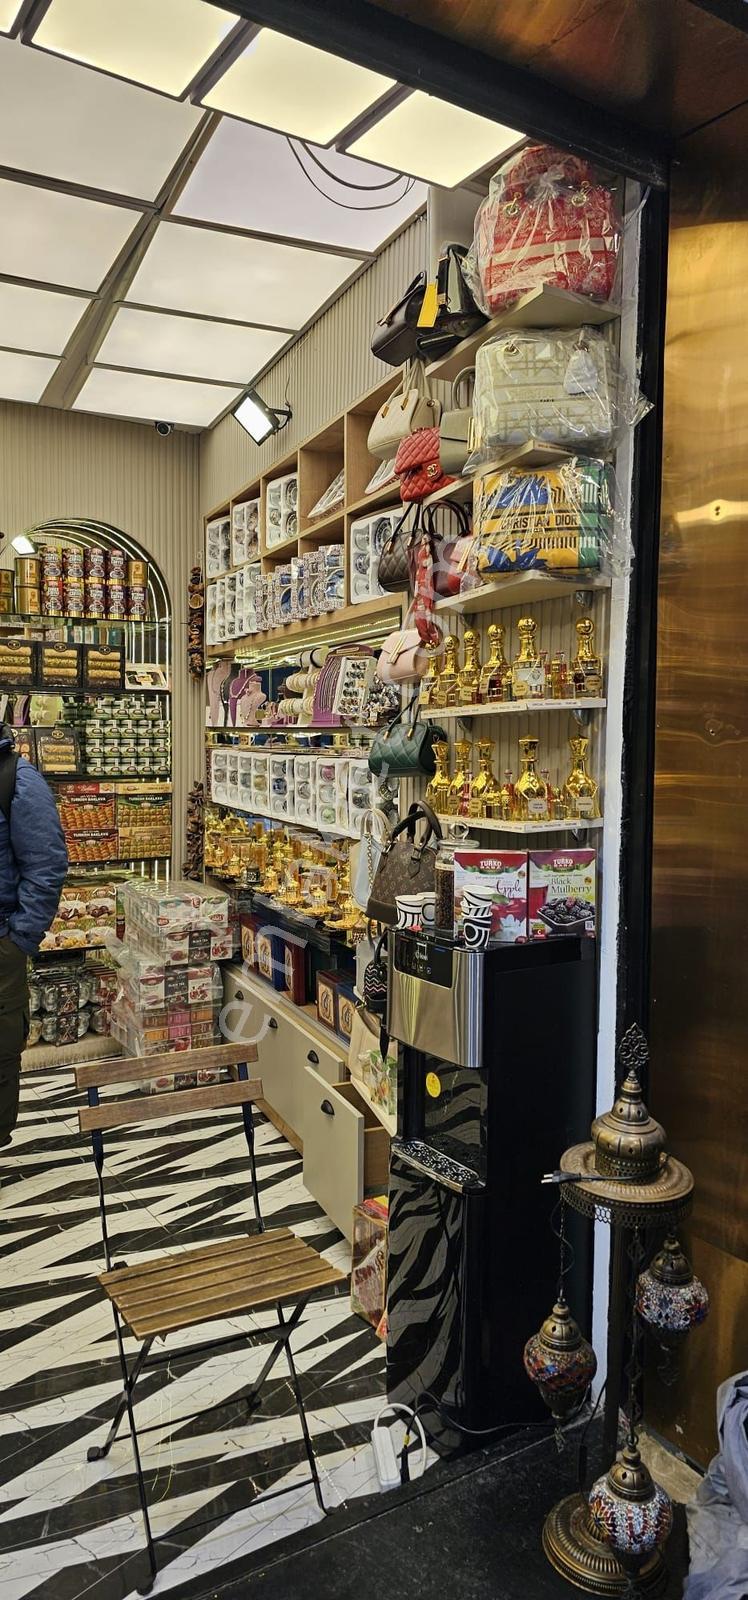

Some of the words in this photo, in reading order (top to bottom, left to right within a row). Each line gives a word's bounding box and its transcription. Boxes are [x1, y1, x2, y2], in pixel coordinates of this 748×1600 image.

[555, 513, 578, 526] DIOR
[551, 877, 572, 885] Black
[551, 885, 592, 895] Mulberry
